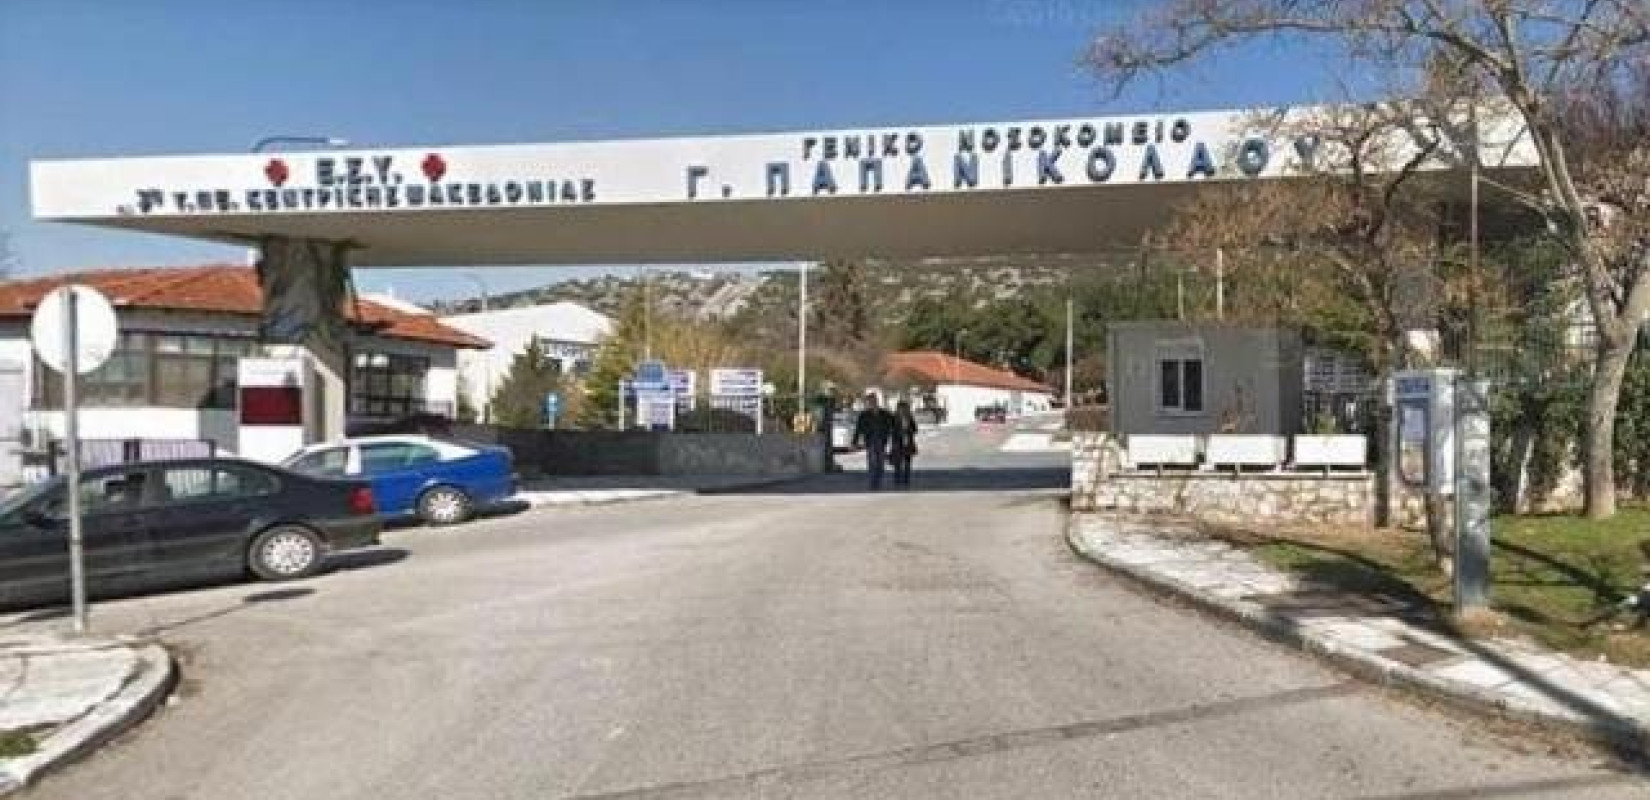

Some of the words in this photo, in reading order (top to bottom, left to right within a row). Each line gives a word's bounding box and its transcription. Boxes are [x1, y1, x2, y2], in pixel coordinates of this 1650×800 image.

[803, 132, 925, 161] ΓΕΝΙΚΟ
[958, 119, 1192, 152] ΝΟΣΟΚΟΜΕΙΟ
[317, 156, 403, 185] Ε.Σ.Υ.
[686, 165, 733, 199] Γ.
[765, 134, 1321, 197] ΠΑΠΑΝΙΚΟΛΑΟΥ
[246, 185, 400, 211] ΚΕΝΤΡΙΚΗΣ
[406, 178, 596, 206] ΜΑΚΕΔΟΝΙΑΣ
